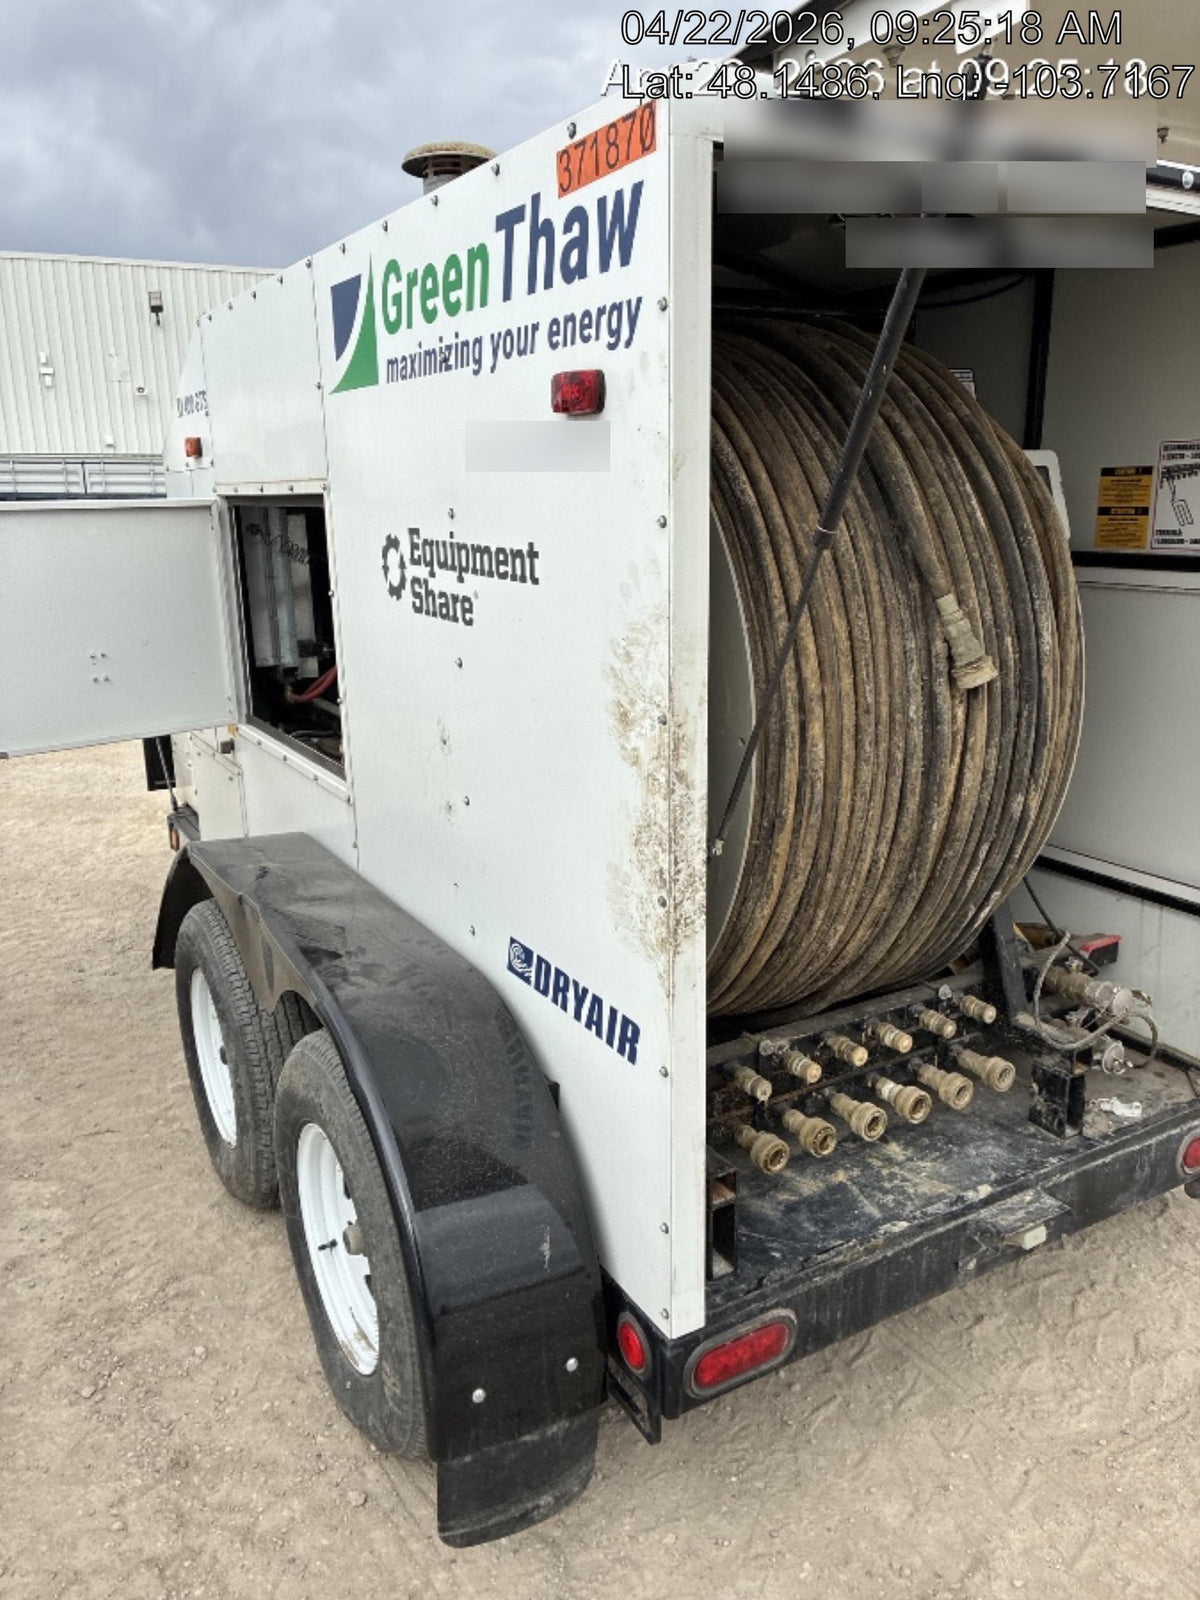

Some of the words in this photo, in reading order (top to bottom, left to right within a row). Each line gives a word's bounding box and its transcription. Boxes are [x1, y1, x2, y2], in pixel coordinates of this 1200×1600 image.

[558, 101, 656, 193] 371870
[386, 331, 483, 385] maximizing
[490, 320, 540, 374] your
[547, 296, 644, 352] energy
[407, 527, 539, 586] Equipment
[410, 575, 474, 627] Share
[533, 953, 641, 1066] DRYAIR
